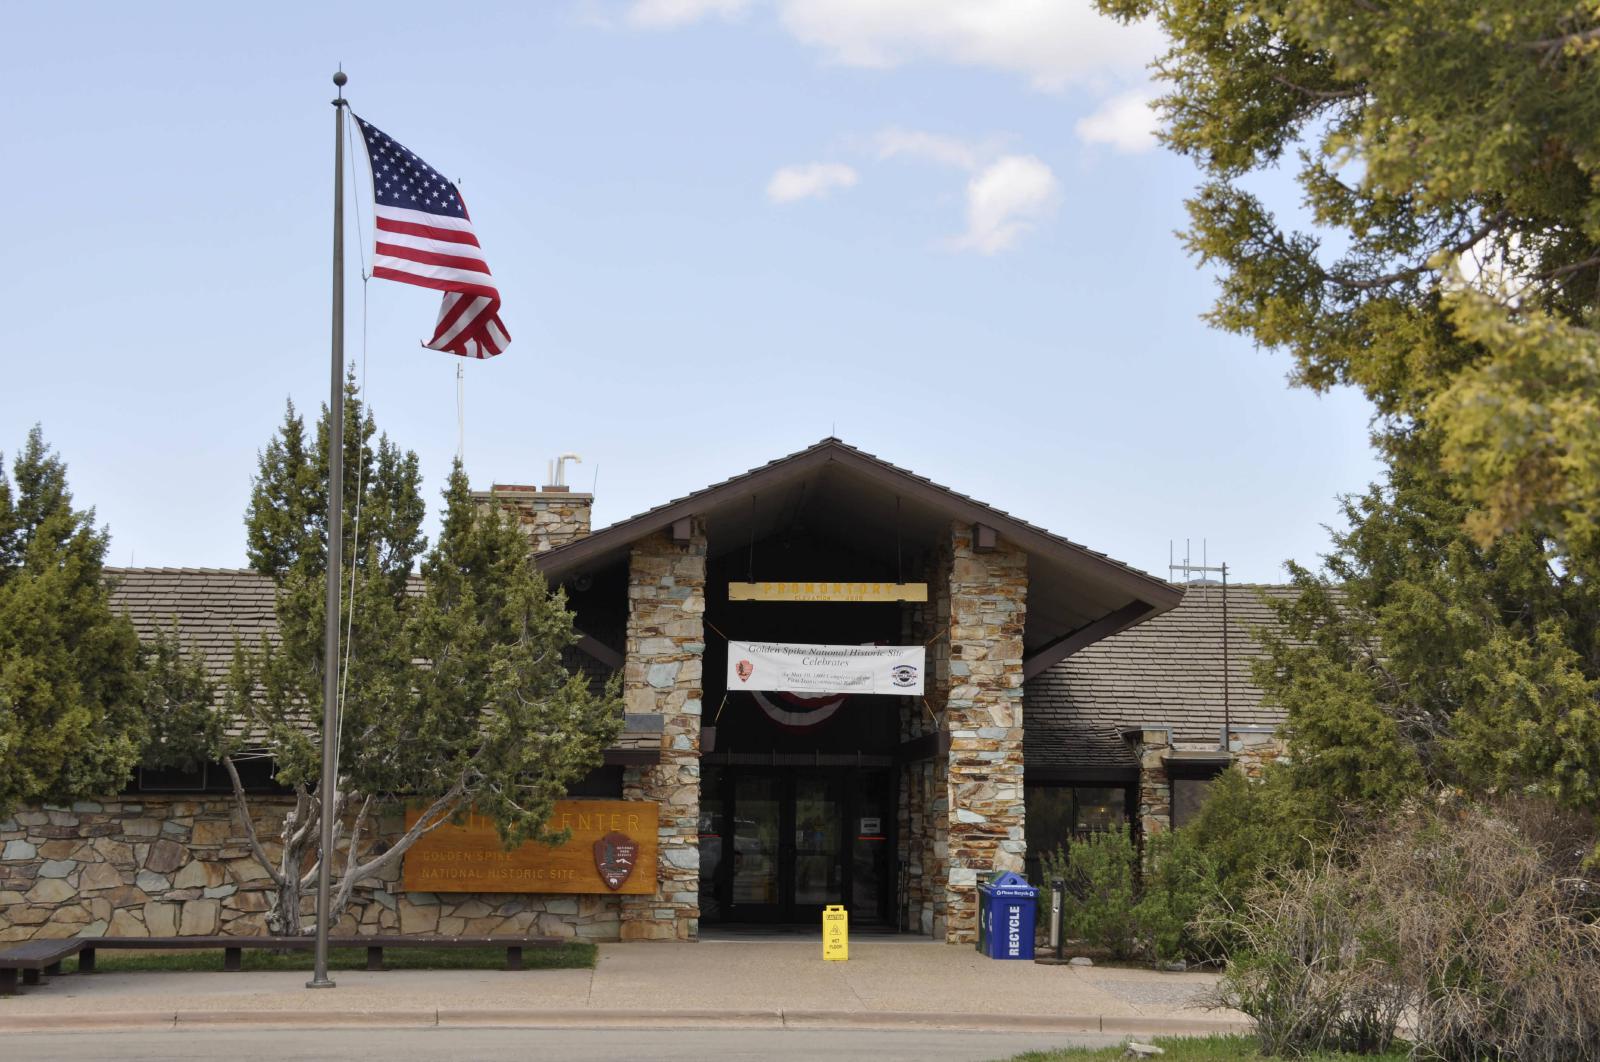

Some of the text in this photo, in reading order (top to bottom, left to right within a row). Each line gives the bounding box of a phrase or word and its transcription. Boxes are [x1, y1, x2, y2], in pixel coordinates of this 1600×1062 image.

[764, 583, 894, 594] PROMONTORY
[748, 645, 905, 657] Golden Spike National Historic Site
[802, 657, 849, 667] Celebrates
[546, 812, 640, 832] ENTER
[423, 851, 513, 862] GOLDEN SPIKE
[421, 868, 576, 880] NATIONAL HISTORIC SITE
[1008, 906, 1020, 956] RECYCLE
